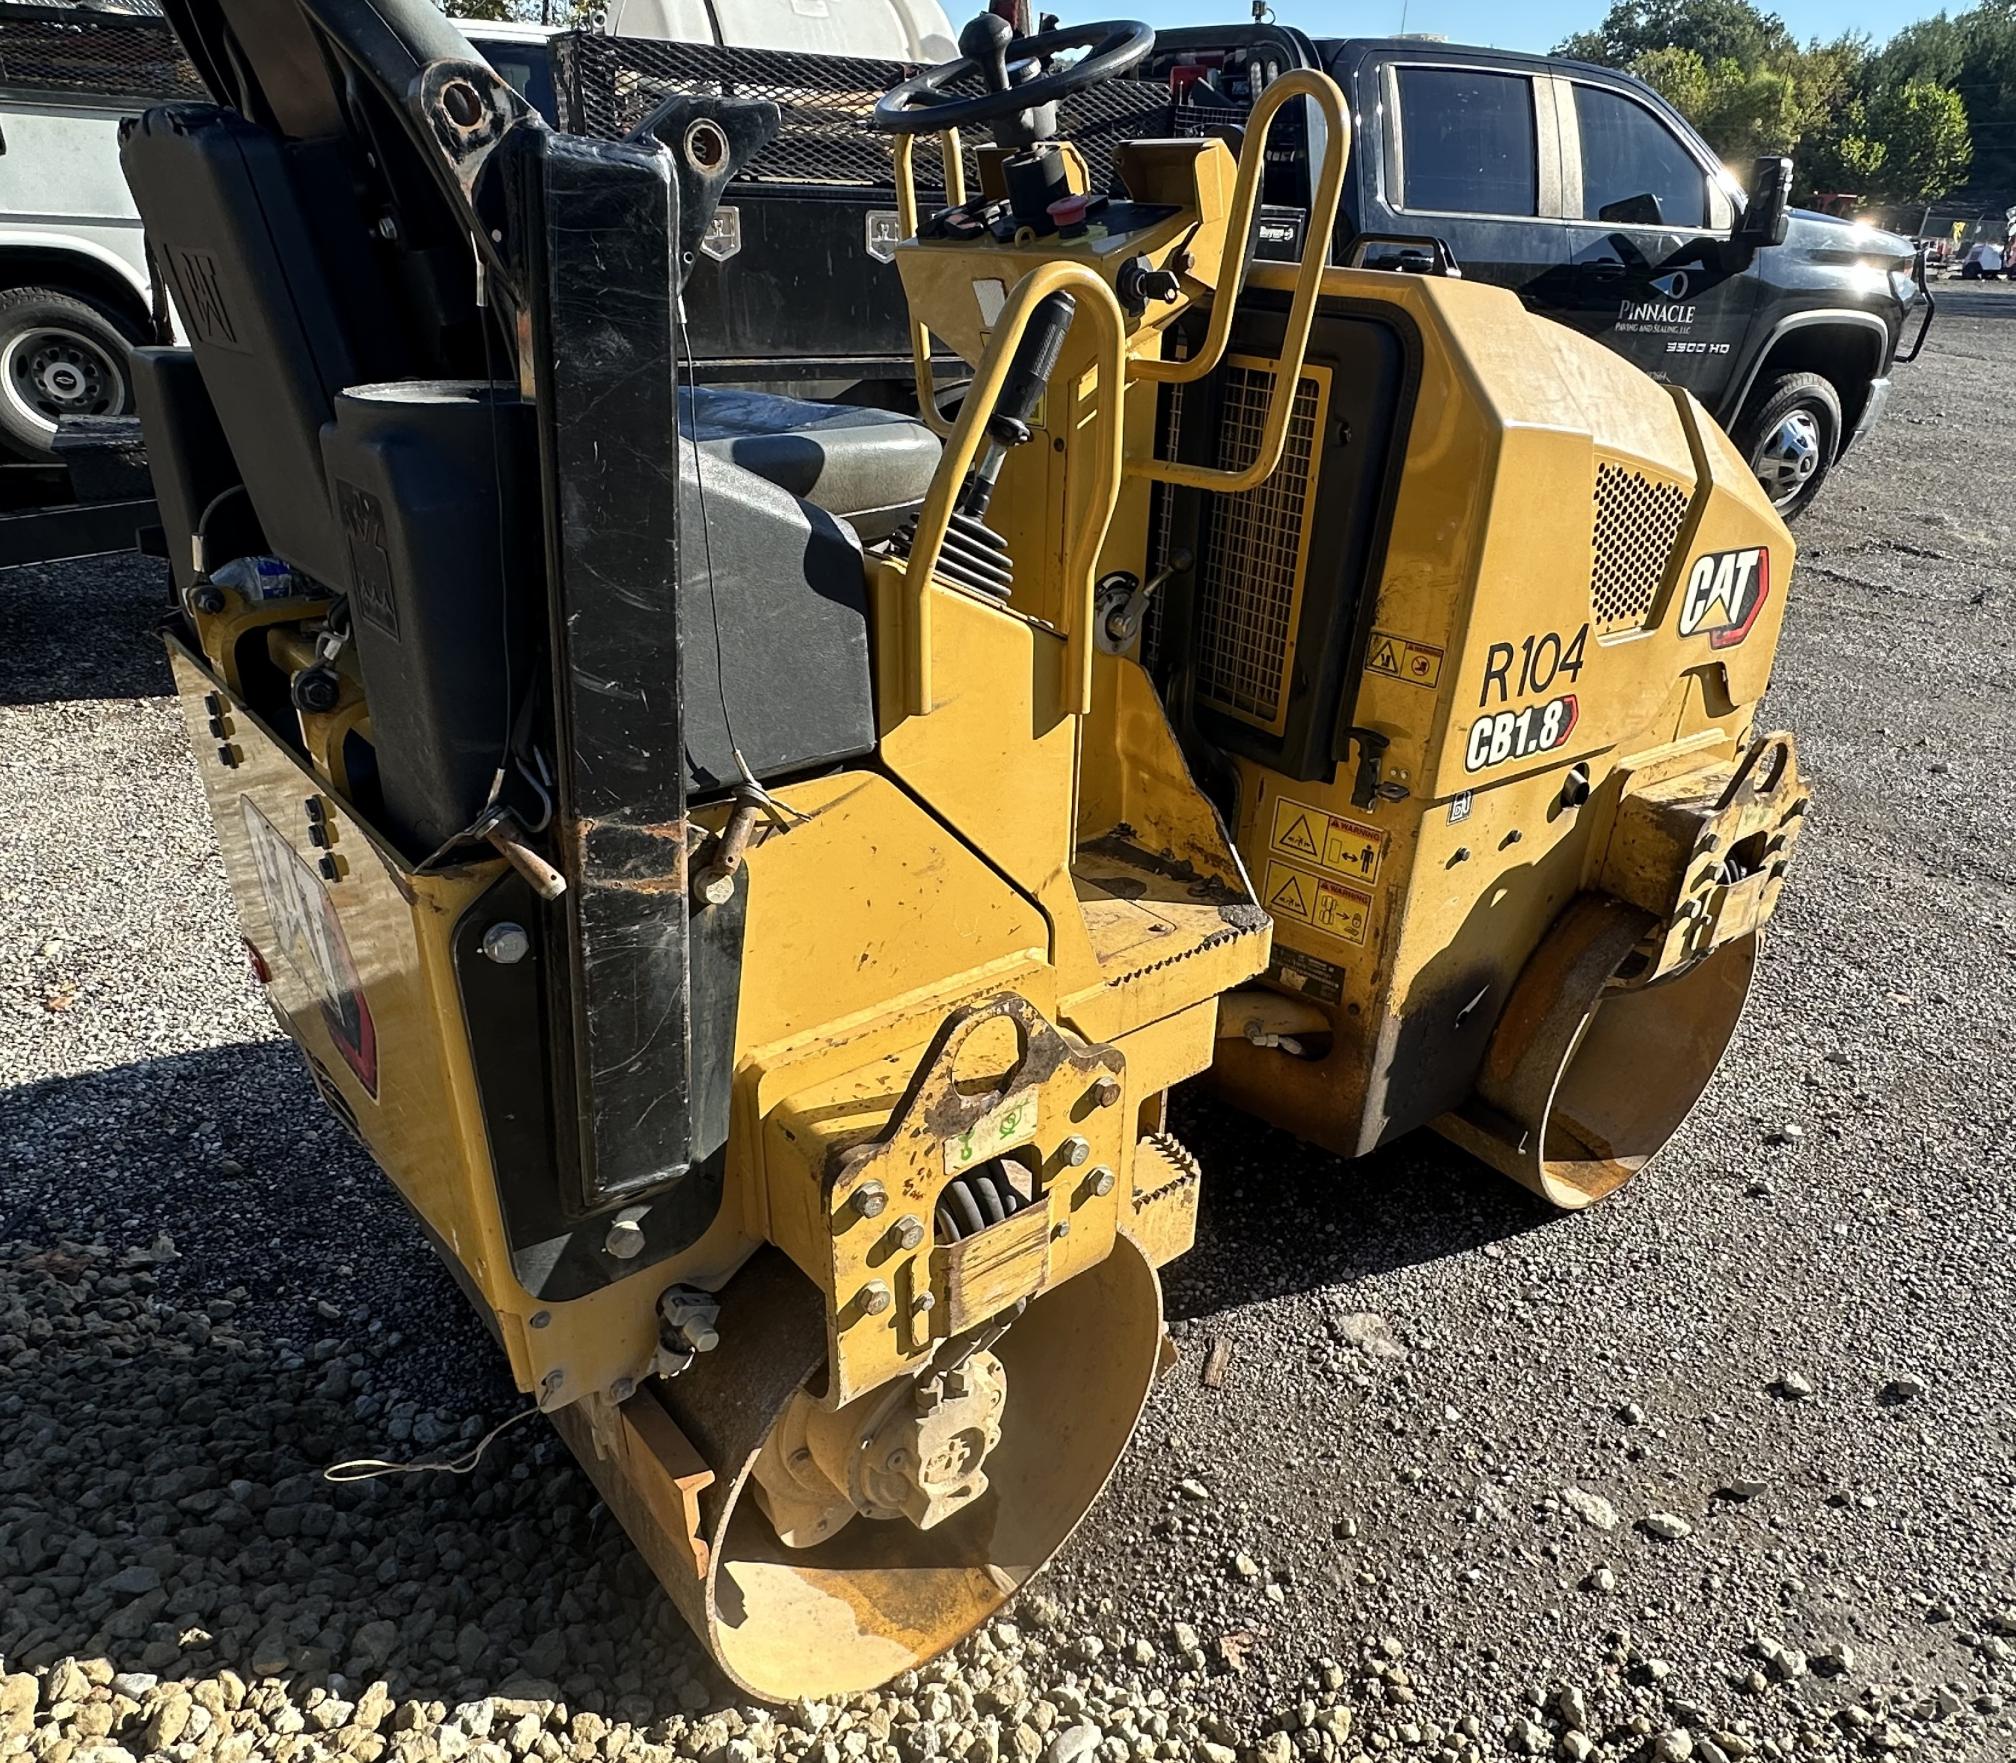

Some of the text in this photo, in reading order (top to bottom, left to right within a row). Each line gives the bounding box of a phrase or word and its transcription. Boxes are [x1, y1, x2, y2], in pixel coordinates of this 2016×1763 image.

[1618, 299, 1696, 323] PINNACLE
[1666, 342, 1731, 354] 3500 HD
[1681, 549, 1761, 635] CAT
[1479, 622, 1590, 707] R104
[1466, 699, 1564, 771] CB1.8
[1340, 822, 1381, 841] WARNING
[1329, 884, 1369, 905] WARNING
